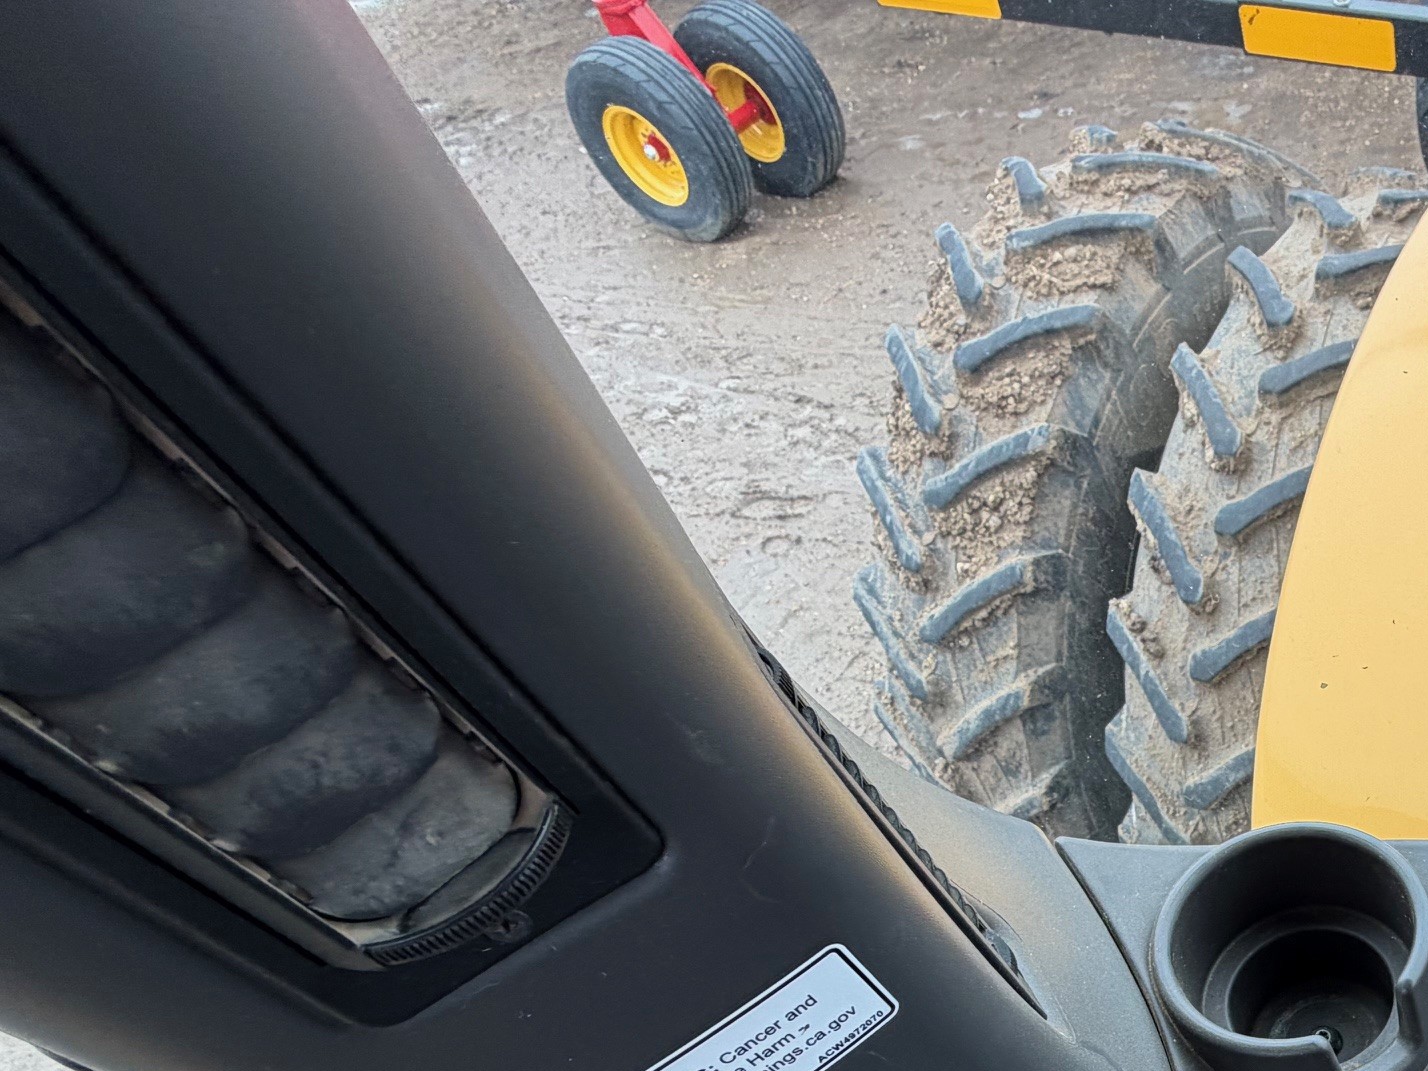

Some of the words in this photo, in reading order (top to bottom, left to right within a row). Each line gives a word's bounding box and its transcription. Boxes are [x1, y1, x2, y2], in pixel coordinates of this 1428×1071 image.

[719, 1020, 782, 1064] Cancer
[785, 994, 818, 1022] and
[746, 1033, 796, 1066] Harm
[818, 1010, 884, 1063] ACW4972070
